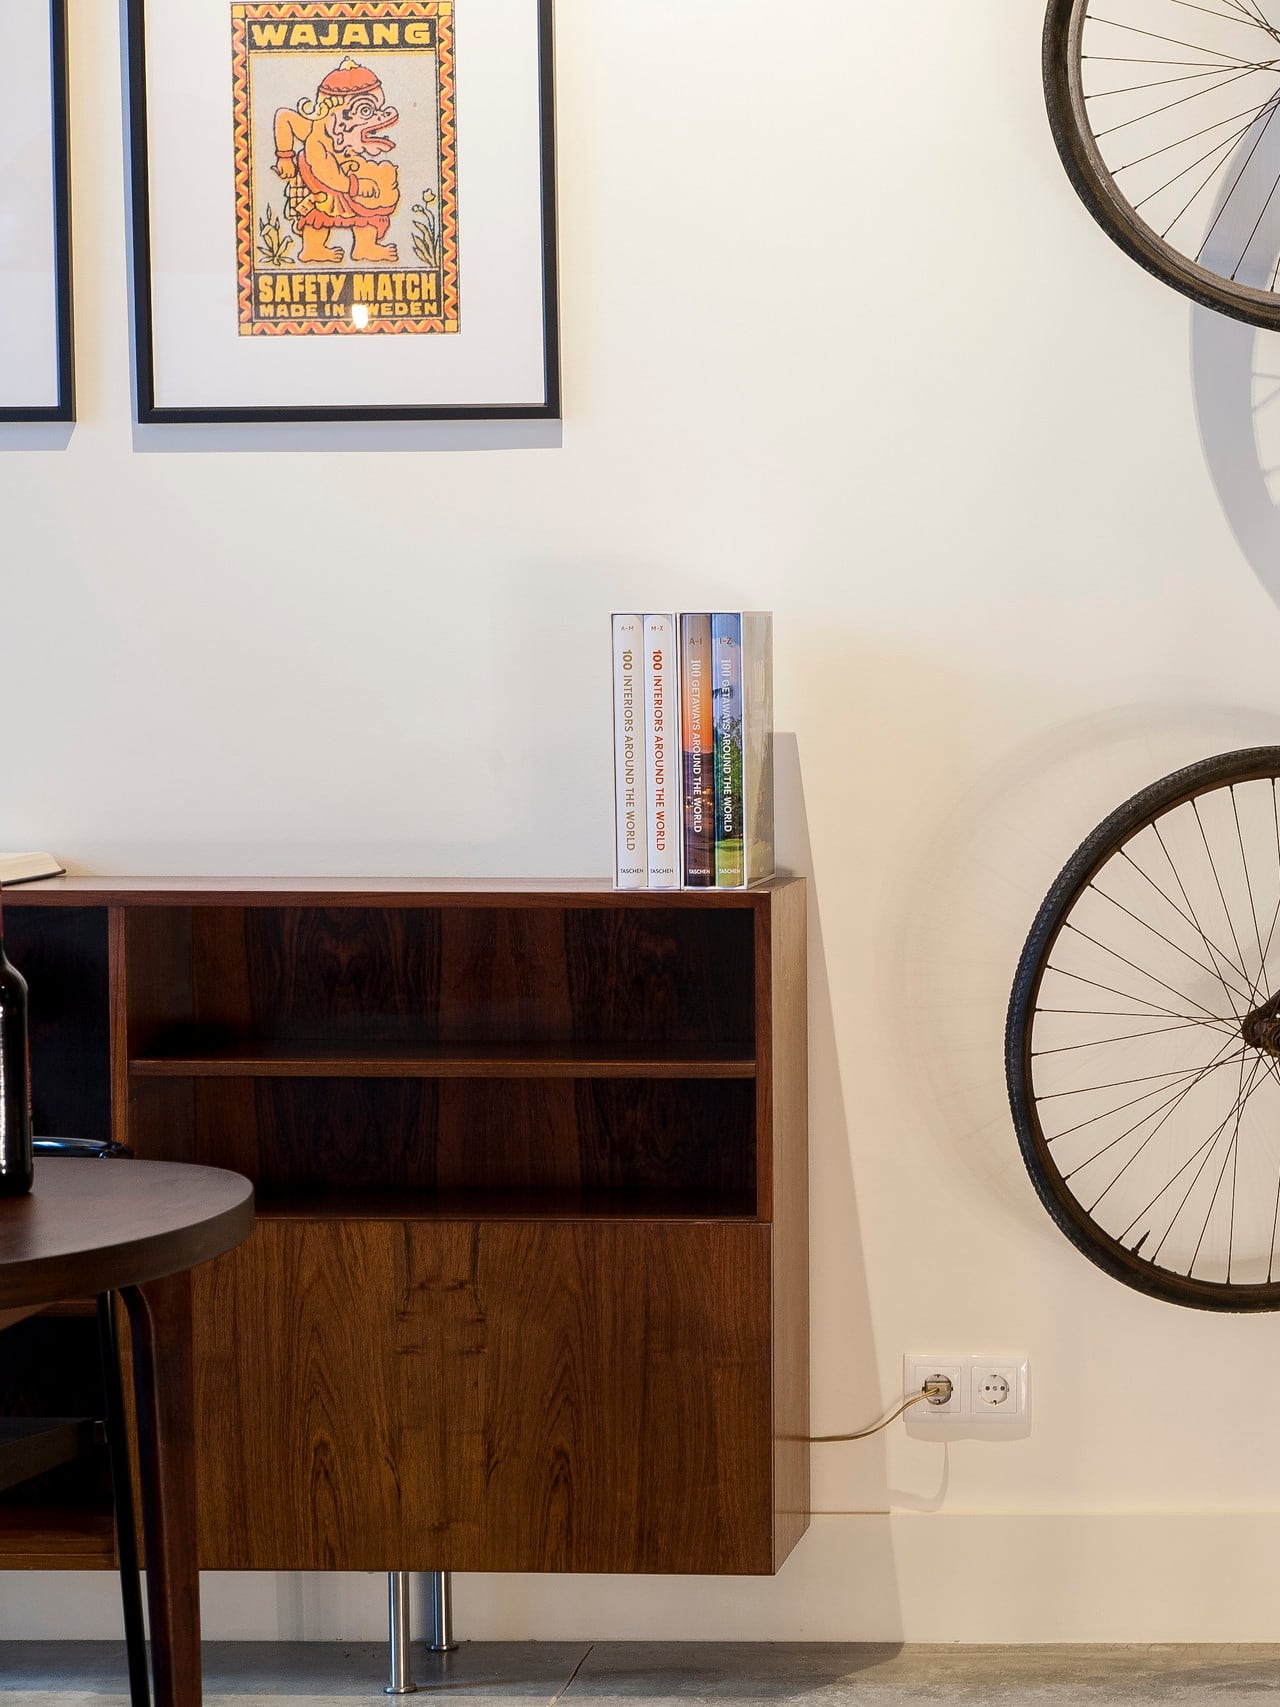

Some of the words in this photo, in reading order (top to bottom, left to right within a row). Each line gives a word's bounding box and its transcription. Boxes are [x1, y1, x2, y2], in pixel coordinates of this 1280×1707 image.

[251, 22, 432, 47] WAJANG
[258, 274, 346, 303] SAFETY
[352, 272, 437, 302] MATCH
[259, 303, 319, 317] MADE
[324, 303, 346, 316] IN
[353, 302, 438, 316] WEDEN
[622, 649, 632, 671] 100
[652, 649, 662, 671] 100
[691, 660, 701, 677] 100
[721, 660, 731, 677] 100
[623, 675, 633, 732] INTERIORS
[653, 675, 663, 732] INTERIORS
[692, 679, 701, 731] GETAWAYS
[721, 679, 731, 731] GETAWAYS
[624, 736, 634, 785] AROUND
[654, 736, 664, 785] AROUND
[692, 732, 701, 774] AROUND
[722, 732, 732, 774] AROUND
[625, 788, 634, 808] THE
[655, 788, 664, 808] THE
[693, 776, 702, 795] THE
[723, 776, 732, 795] THE
[626, 811, 635, 851] WORLD
[656, 811, 665, 851] WORLD
[693, 797, 702, 833] WORLD
[723, 797, 732, 833] WORLD
